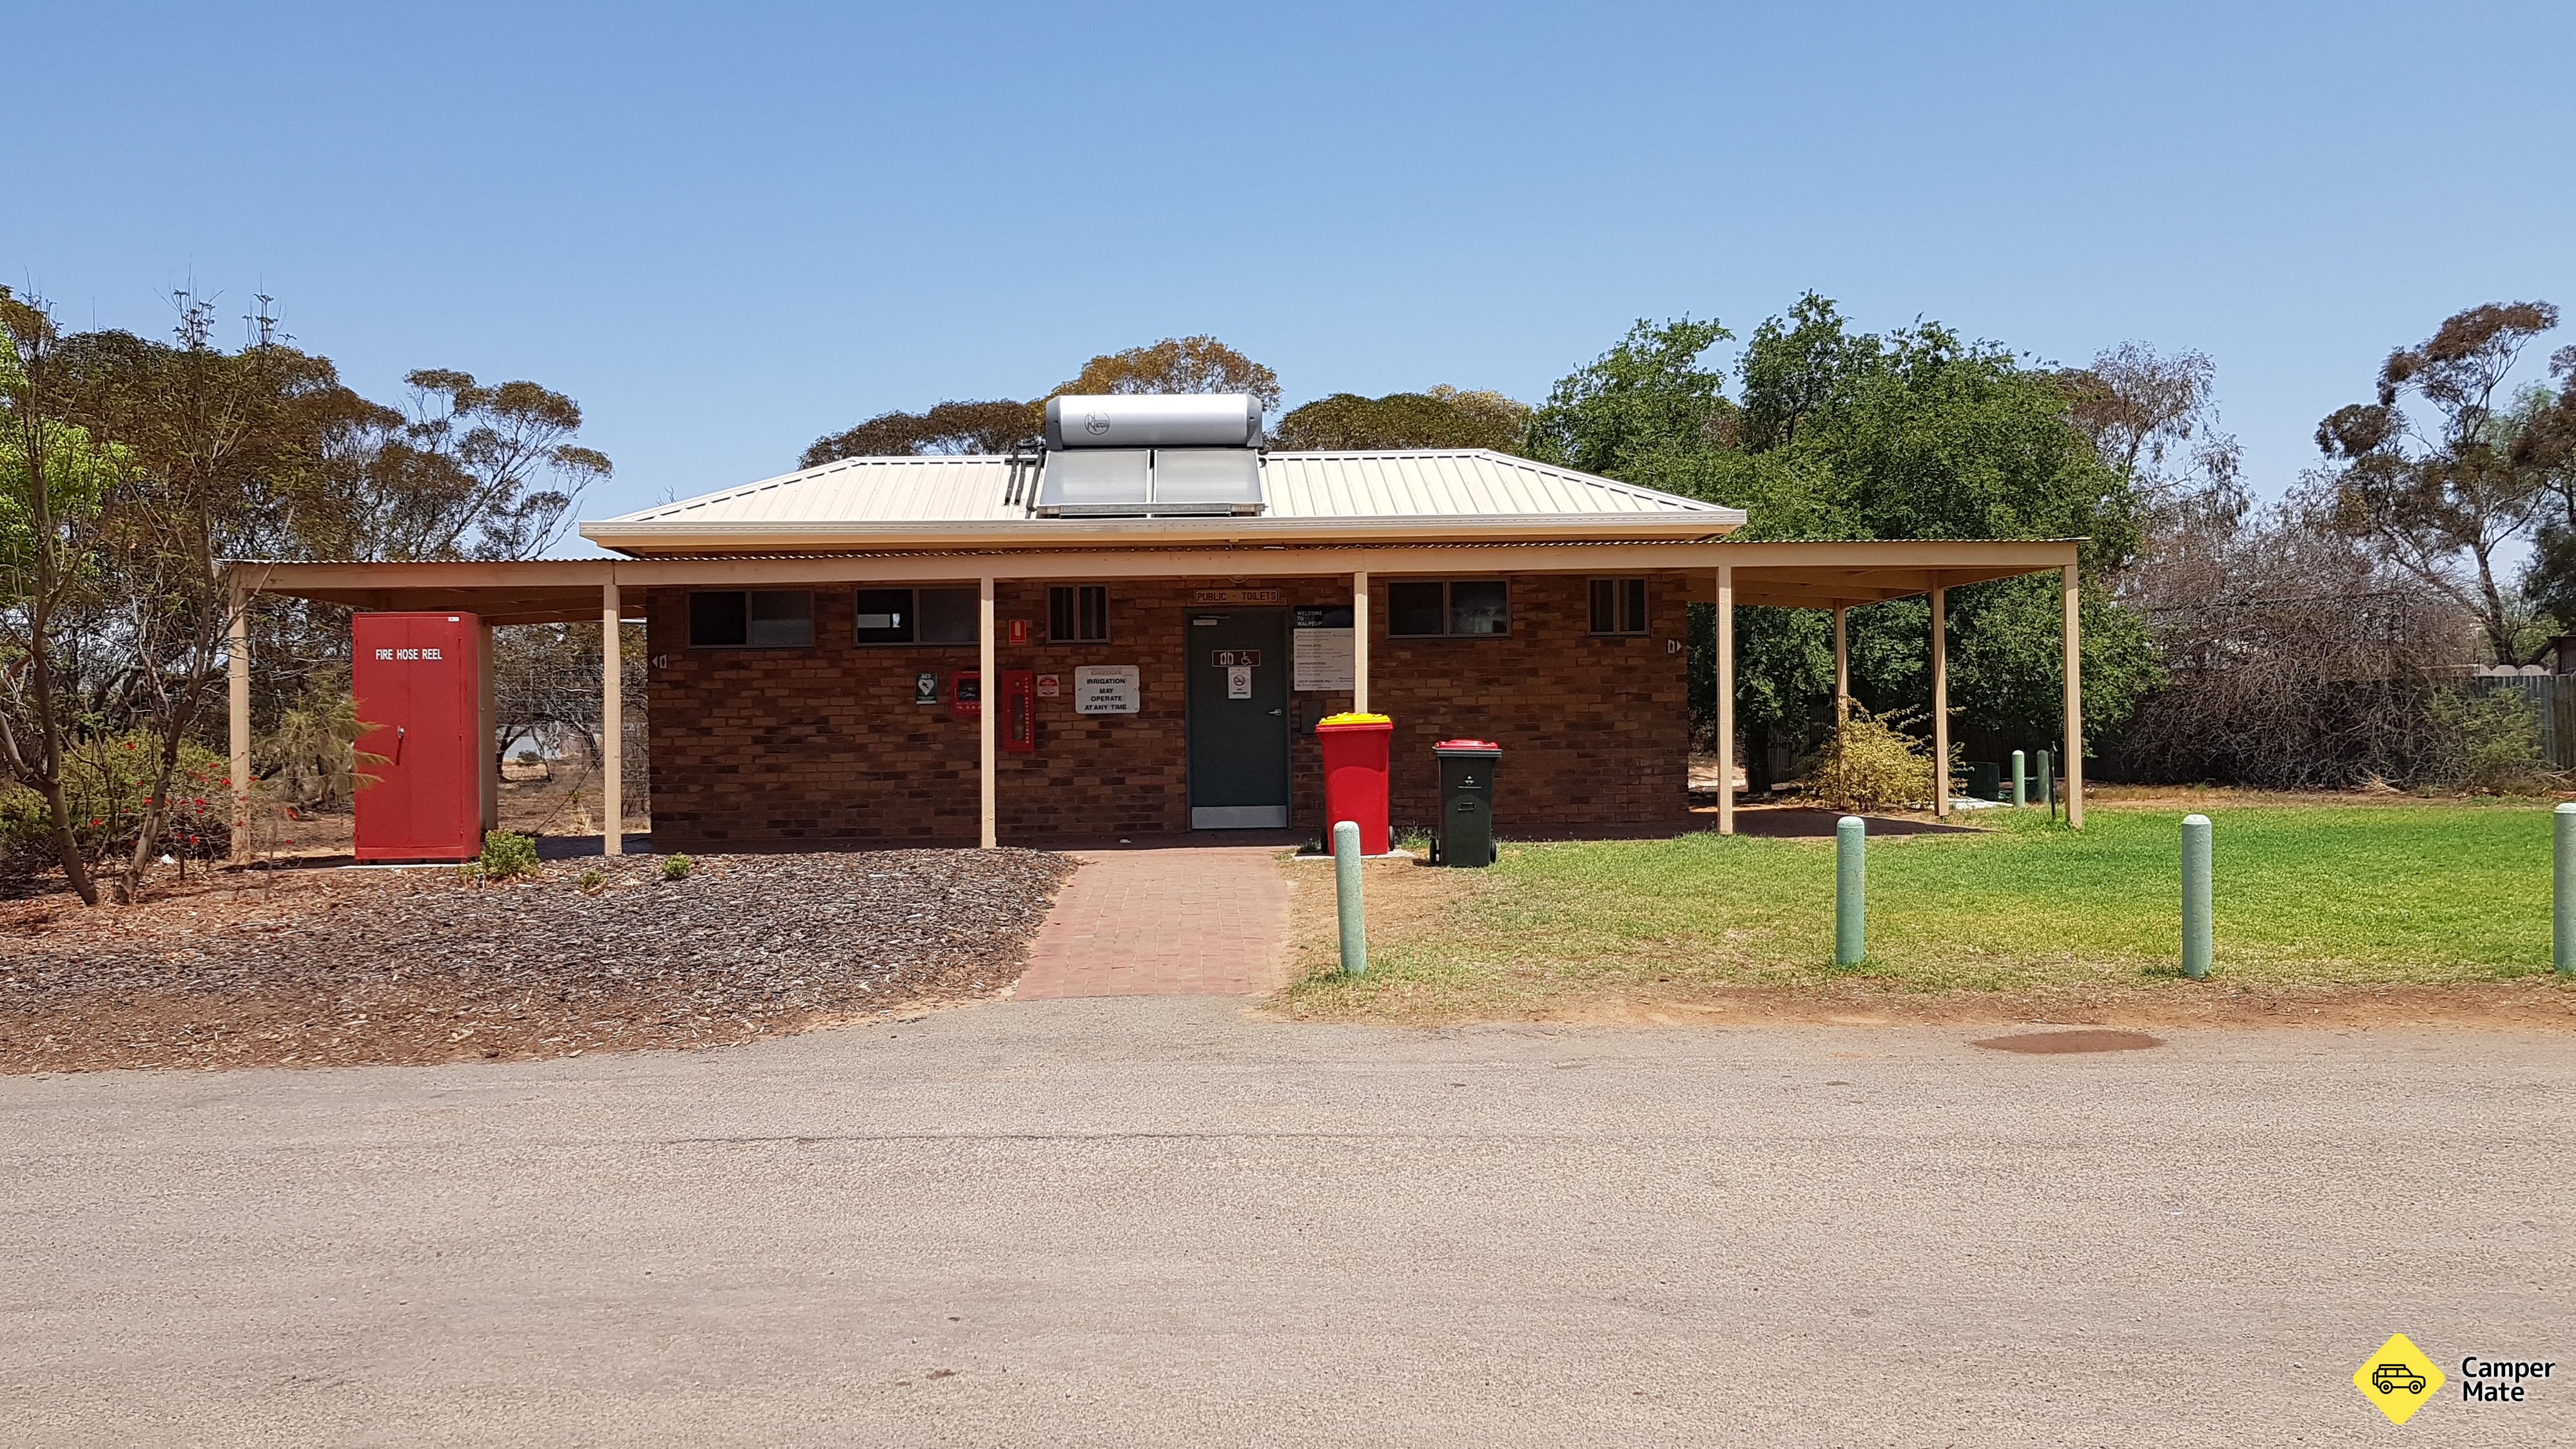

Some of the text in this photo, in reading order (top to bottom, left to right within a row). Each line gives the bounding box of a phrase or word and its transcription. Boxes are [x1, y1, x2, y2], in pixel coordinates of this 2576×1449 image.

[1197, 592, 1227, 601] PUBLIC
[1242, 592, 1276, 600] TOILETS
[376, 648, 443, 660] FIRE HOSE REEL
